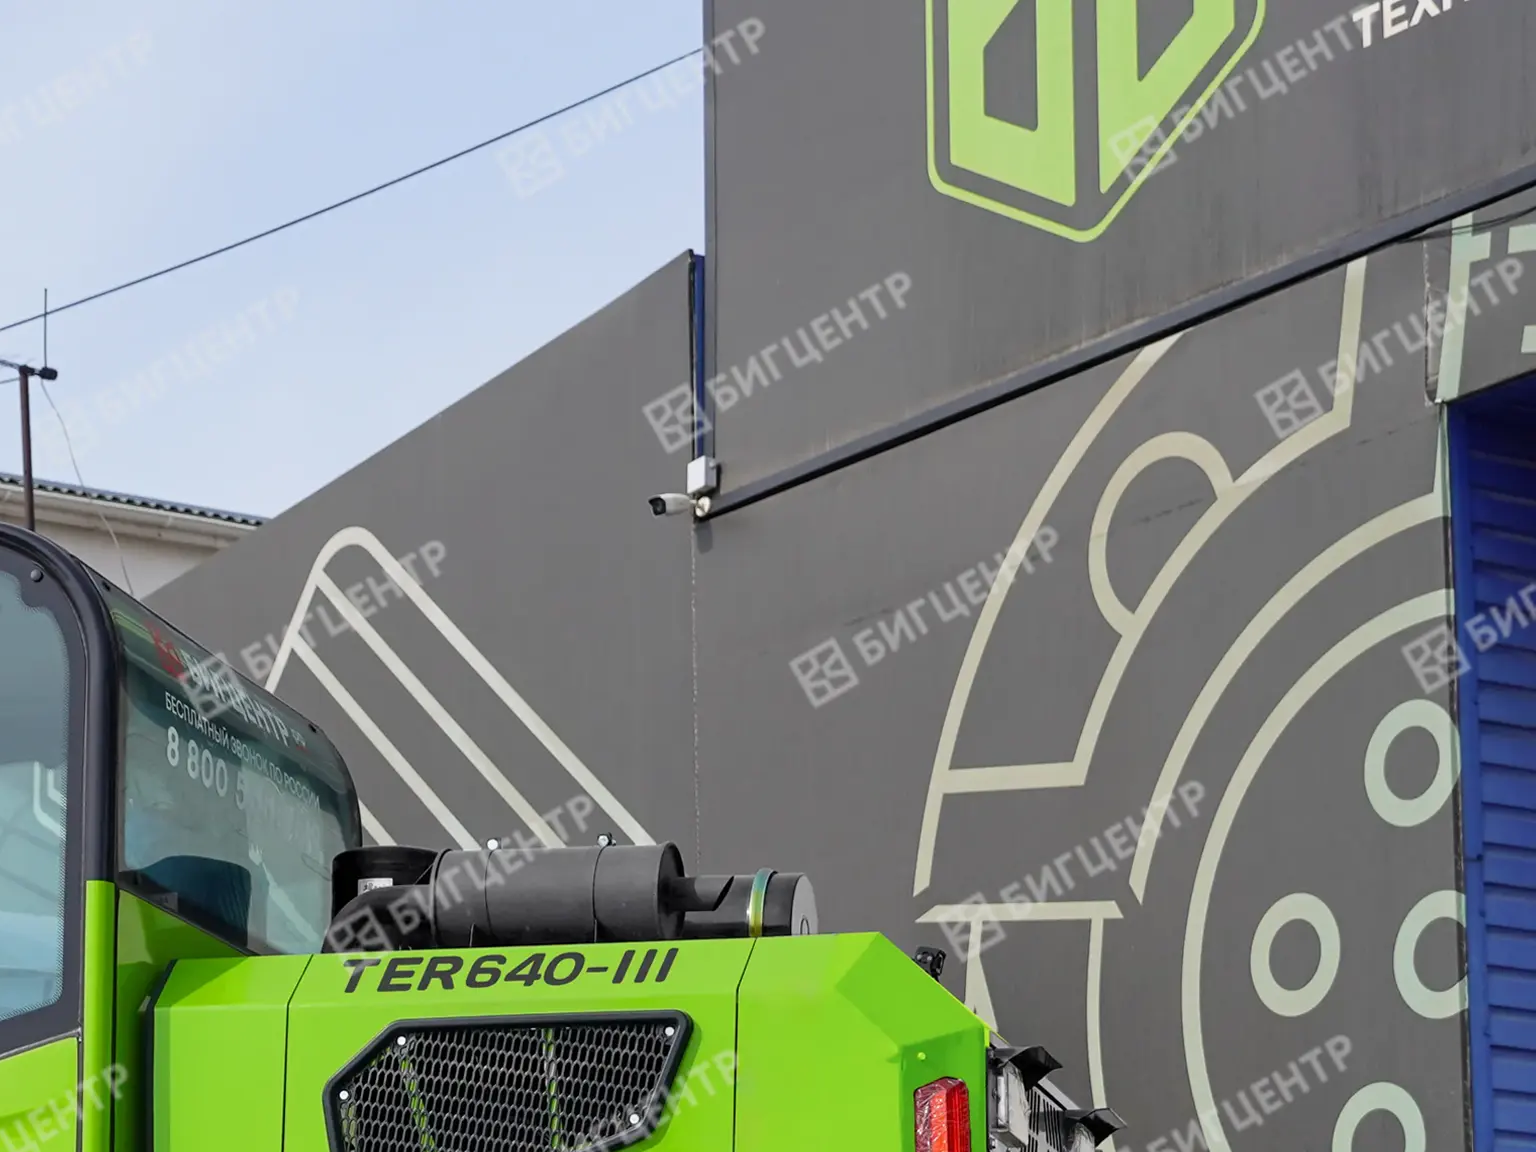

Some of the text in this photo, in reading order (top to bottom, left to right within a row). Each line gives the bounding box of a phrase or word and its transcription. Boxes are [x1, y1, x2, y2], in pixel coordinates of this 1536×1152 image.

[165, 691, 230, 752] БЕСПЛАТНЫЙ
[230, 735, 268, 777] ЗВОНОК
[269, 760, 283, 785] ПО
[283, 771, 321, 812] РОССИИ
[167, 726, 228, 798] 8 800
[343, 947, 679, 994] TER640-III
